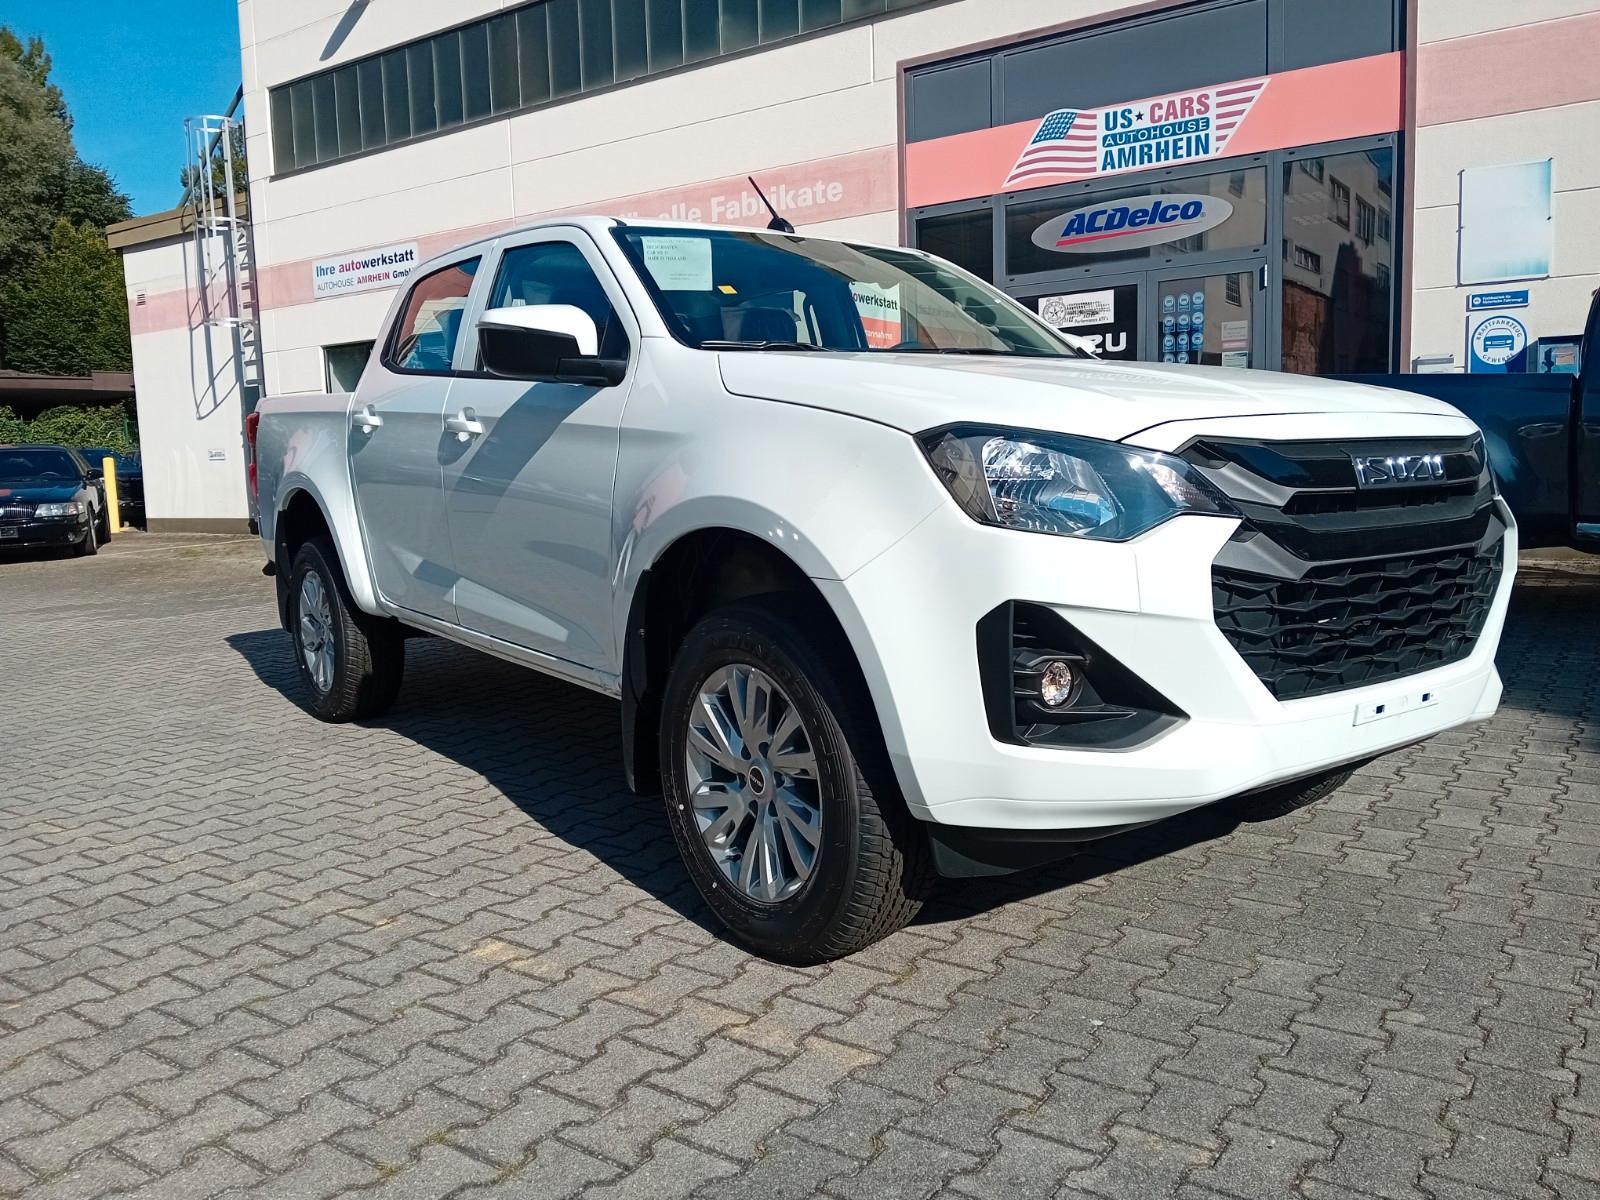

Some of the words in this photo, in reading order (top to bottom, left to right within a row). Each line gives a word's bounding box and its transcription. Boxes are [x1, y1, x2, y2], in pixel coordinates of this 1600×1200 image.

[1105, 108, 1133, 132] US
[1150, 93, 1210, 124] CARS
[1104, 120, 1208, 147] AUTOHOUSE
[1101, 133, 1210, 171] AMRHEIN
[711, 179, 843, 223] Fabrikate
[1061, 200, 1203, 237] ACDelco
[316, 265, 336, 278] Ihre
[338, 249, 414, 273] autowerkstatt
[356, 271, 390, 285] AMRHEIN
[1355, 454, 1446, 484] ISUZU
